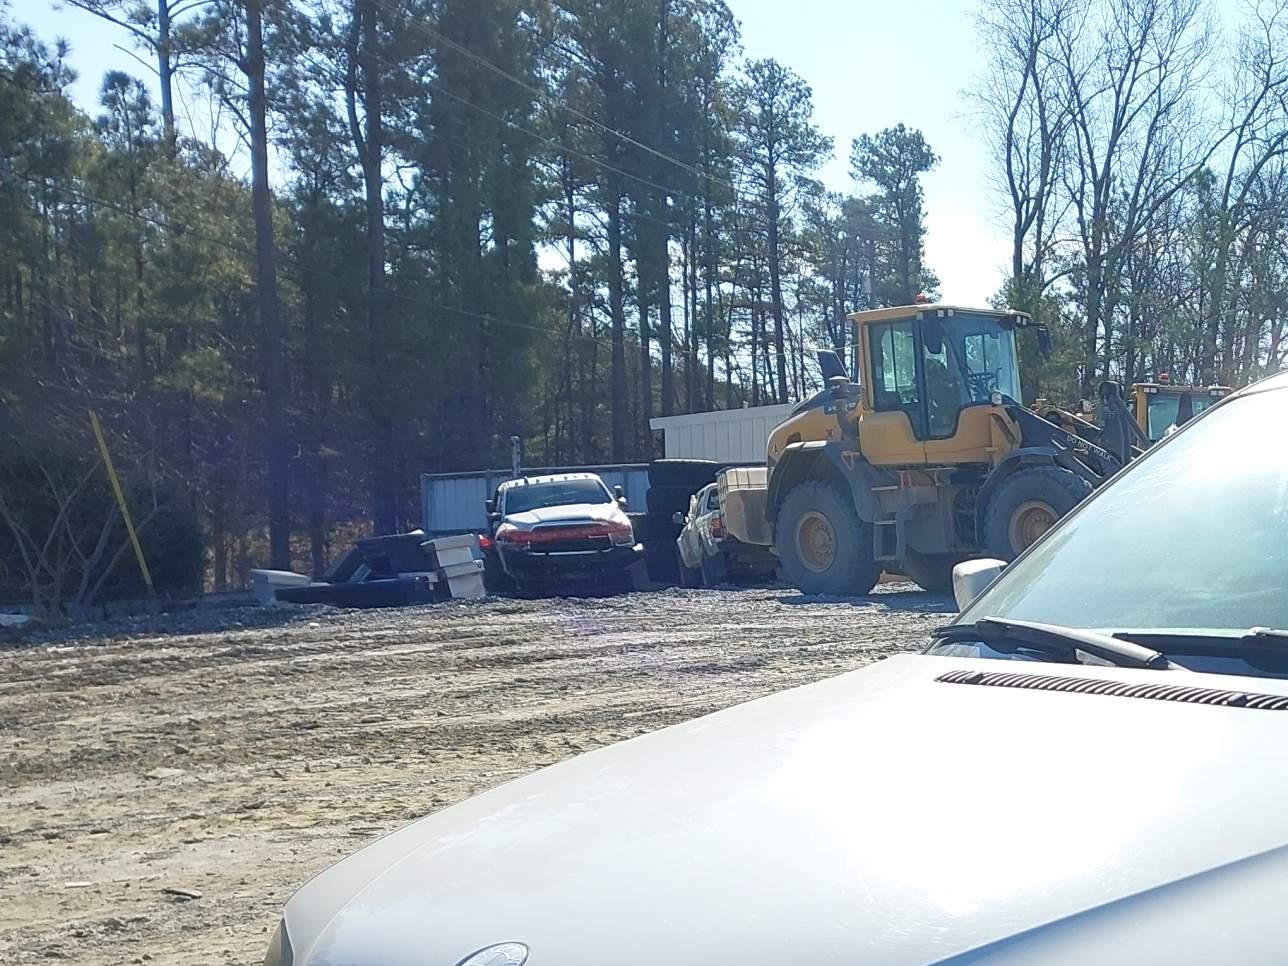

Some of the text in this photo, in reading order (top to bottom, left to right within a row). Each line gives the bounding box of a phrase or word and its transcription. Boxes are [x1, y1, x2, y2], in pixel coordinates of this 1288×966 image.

[1066, 435, 1112, 462] DO NOT WALK
